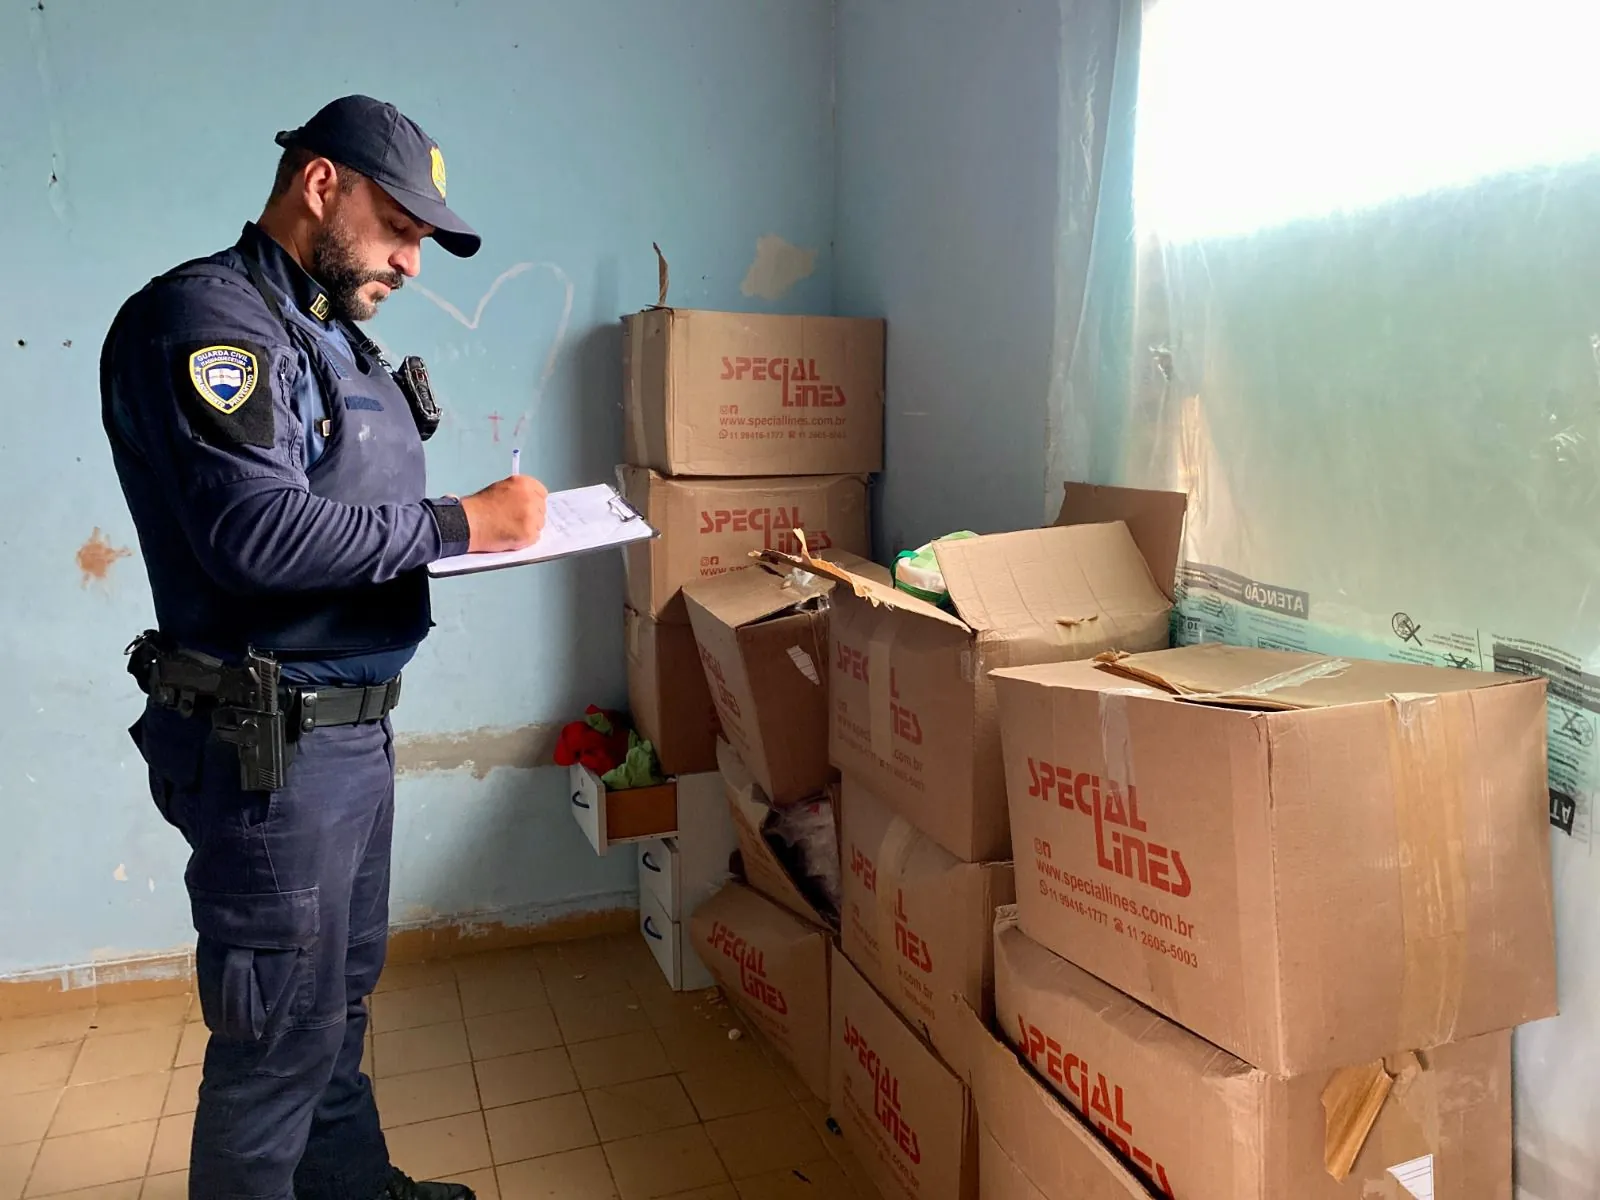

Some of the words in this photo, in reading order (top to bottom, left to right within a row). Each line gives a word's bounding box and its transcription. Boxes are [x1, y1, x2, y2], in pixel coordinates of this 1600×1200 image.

[197, 350, 229, 362] GUARDA
[230, 351, 249, 363] CIVIL
[720, 357, 820, 381] SPECIAL
[719, 415, 847, 429] www.speciallines.com.br
[782, 385, 847, 408] LINES
[700, 506, 805, 534] SPECIAL
[1027, 757, 1147, 833] SPECIAL
[1096, 829, 1192, 898] LINES
[1036, 858, 1195, 940] www.speciallines.com.br
[707, 920, 767, 978] SPECIAL
[1127, 925, 1138, 941] 11
[1140, 930, 1198, 969] 2605-5003
[843, 1015, 901, 1112] SPECIAL
[1018, 1013, 1132, 1136] SPECIAL
